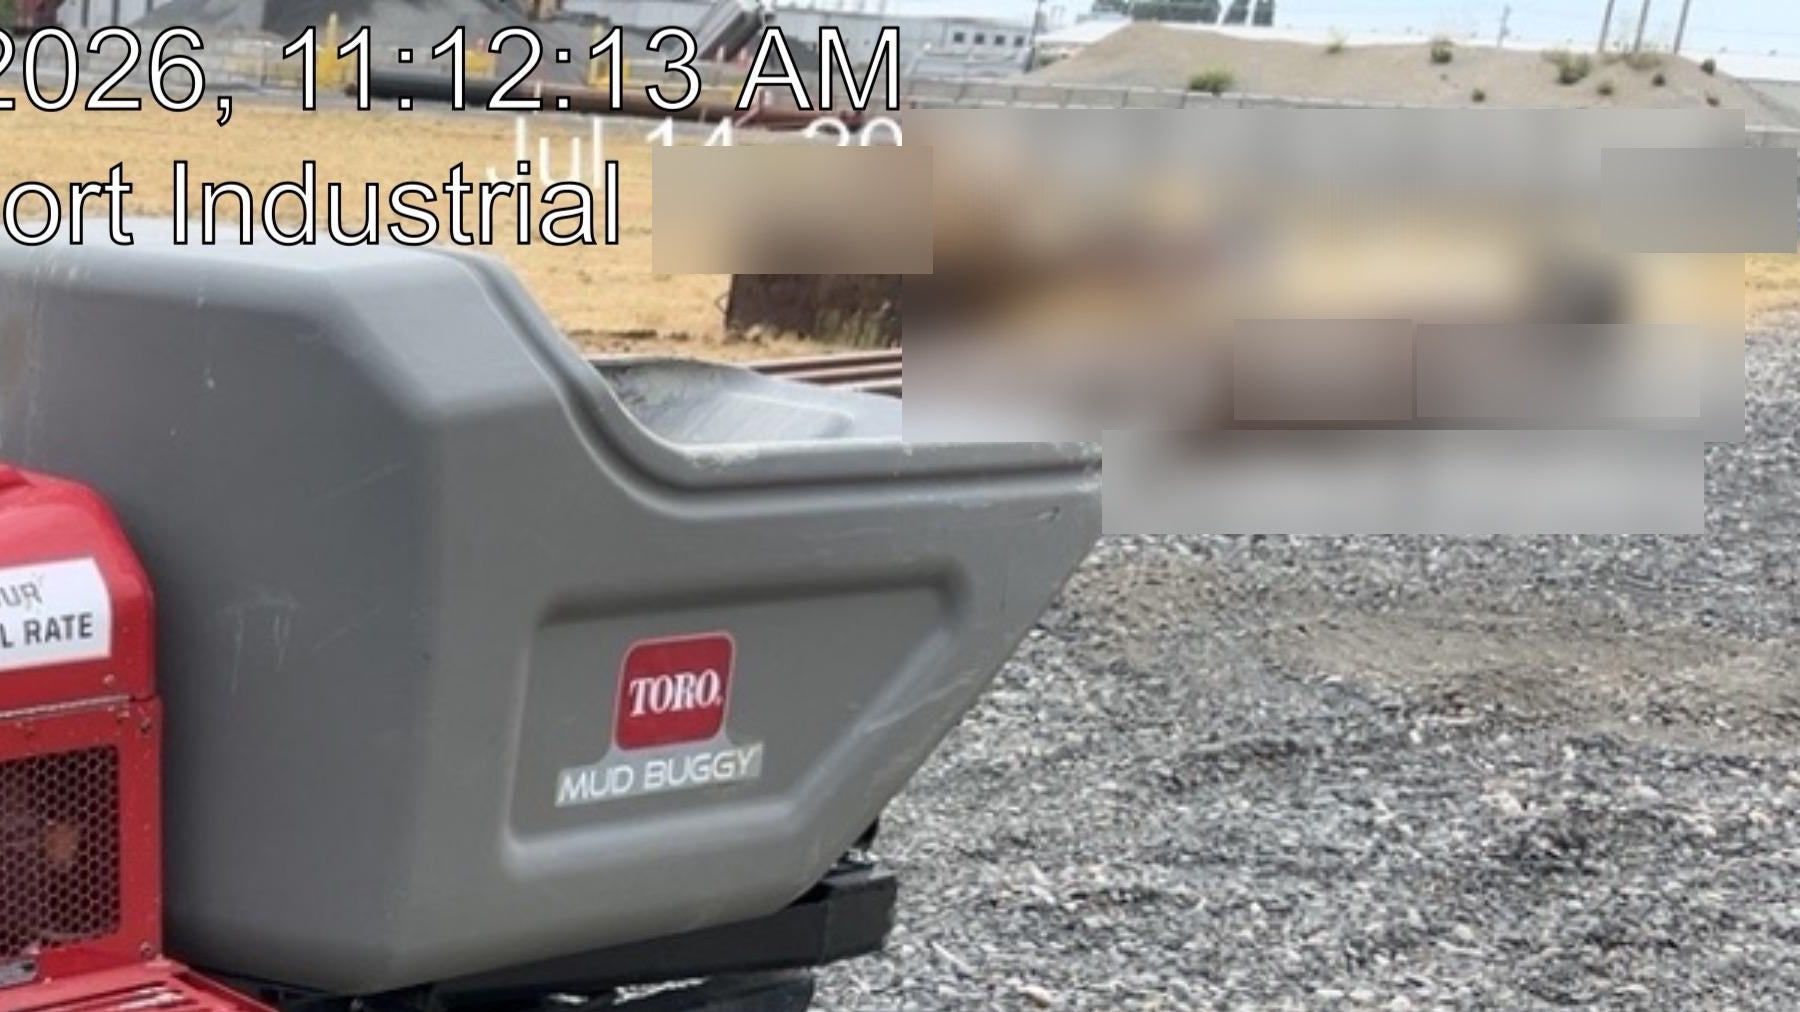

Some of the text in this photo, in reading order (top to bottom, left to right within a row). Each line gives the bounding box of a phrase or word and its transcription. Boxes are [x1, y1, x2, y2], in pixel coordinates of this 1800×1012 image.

[23, 611, 94, 646] RATE
[628, 668, 722, 718] TORO
[555, 743, 763, 806] MUD BUGGY
